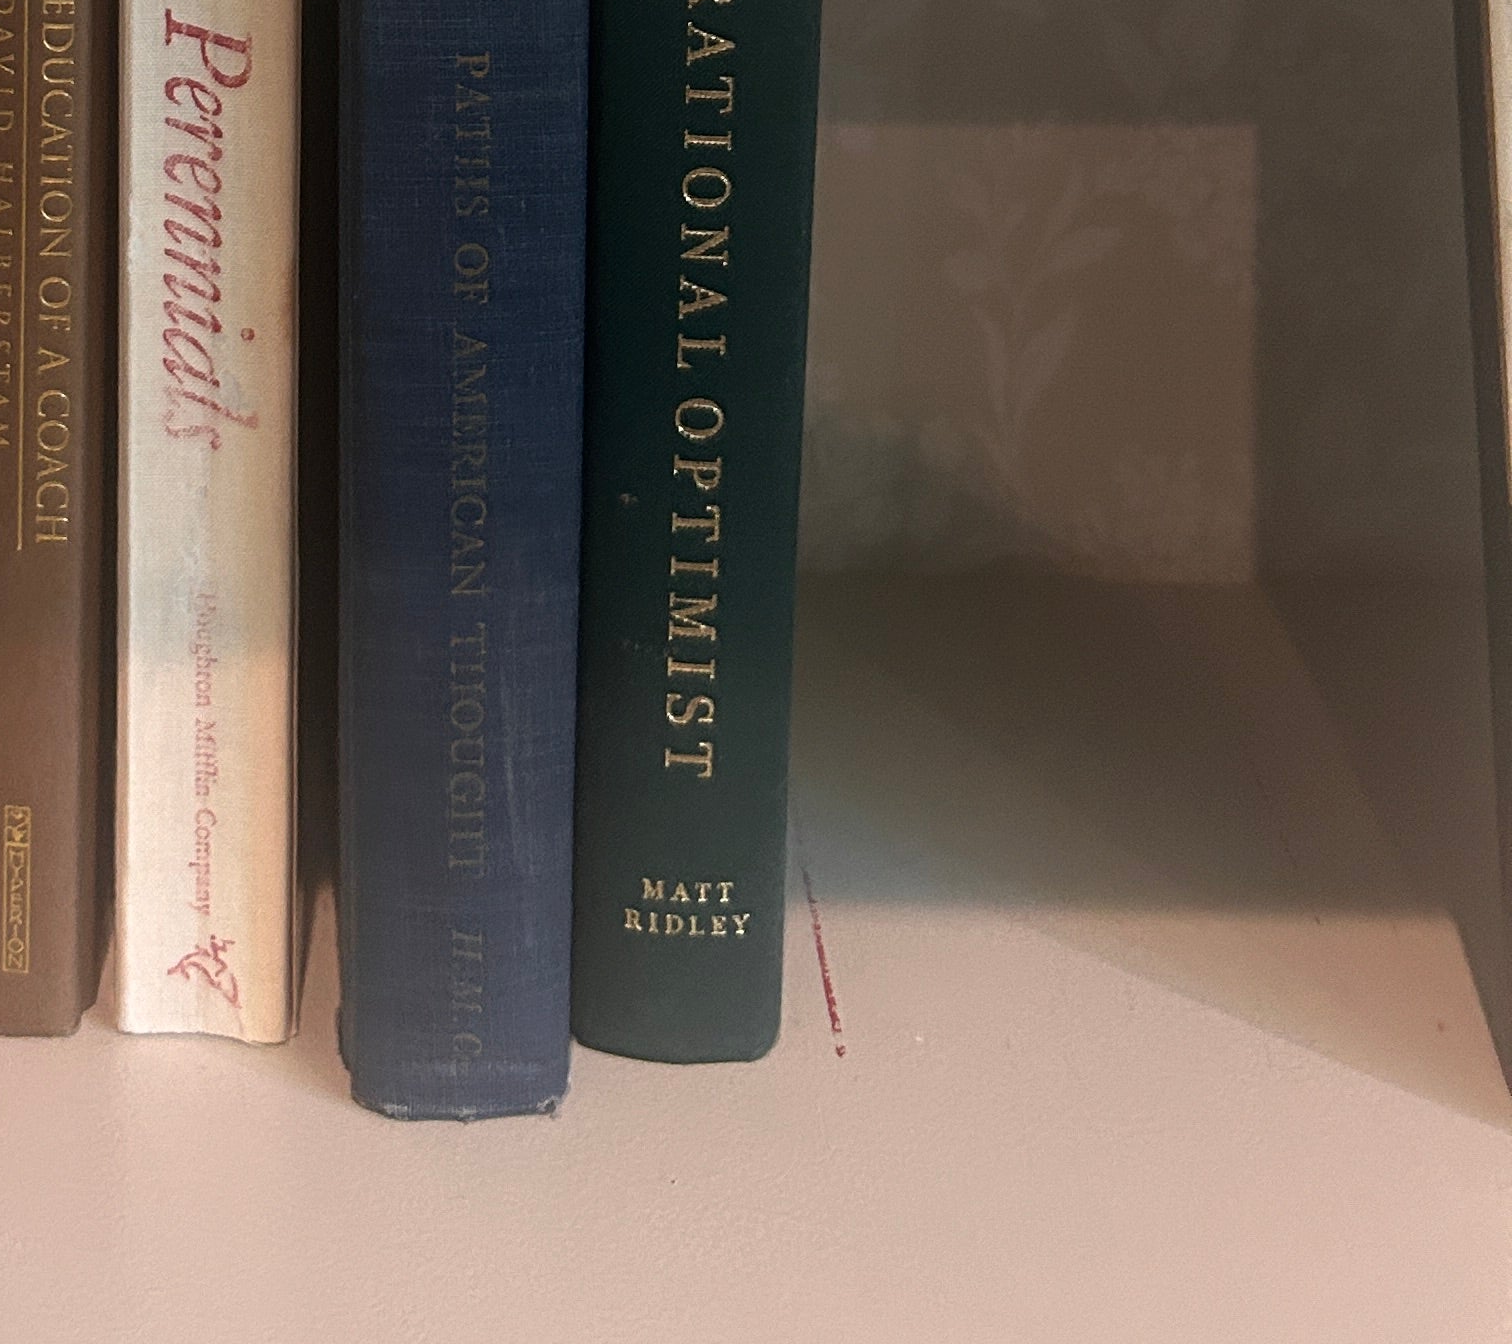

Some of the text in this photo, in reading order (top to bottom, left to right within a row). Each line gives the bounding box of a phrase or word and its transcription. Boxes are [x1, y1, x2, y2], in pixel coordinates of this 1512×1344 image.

[162, 7, 259, 451] Perennials
[37, 346, 71, 375] A
[39, 276, 72, 332] OF
[35, 389, 70, 544] COACH
[447, 50, 493, 874] PATHS OF AMERICAN THOUGHT
[664, 397, 724, 779] OPTIMIST
[188, 807, 214, 916] Company
[624, 877, 751, 936] MATT RIDLEY
